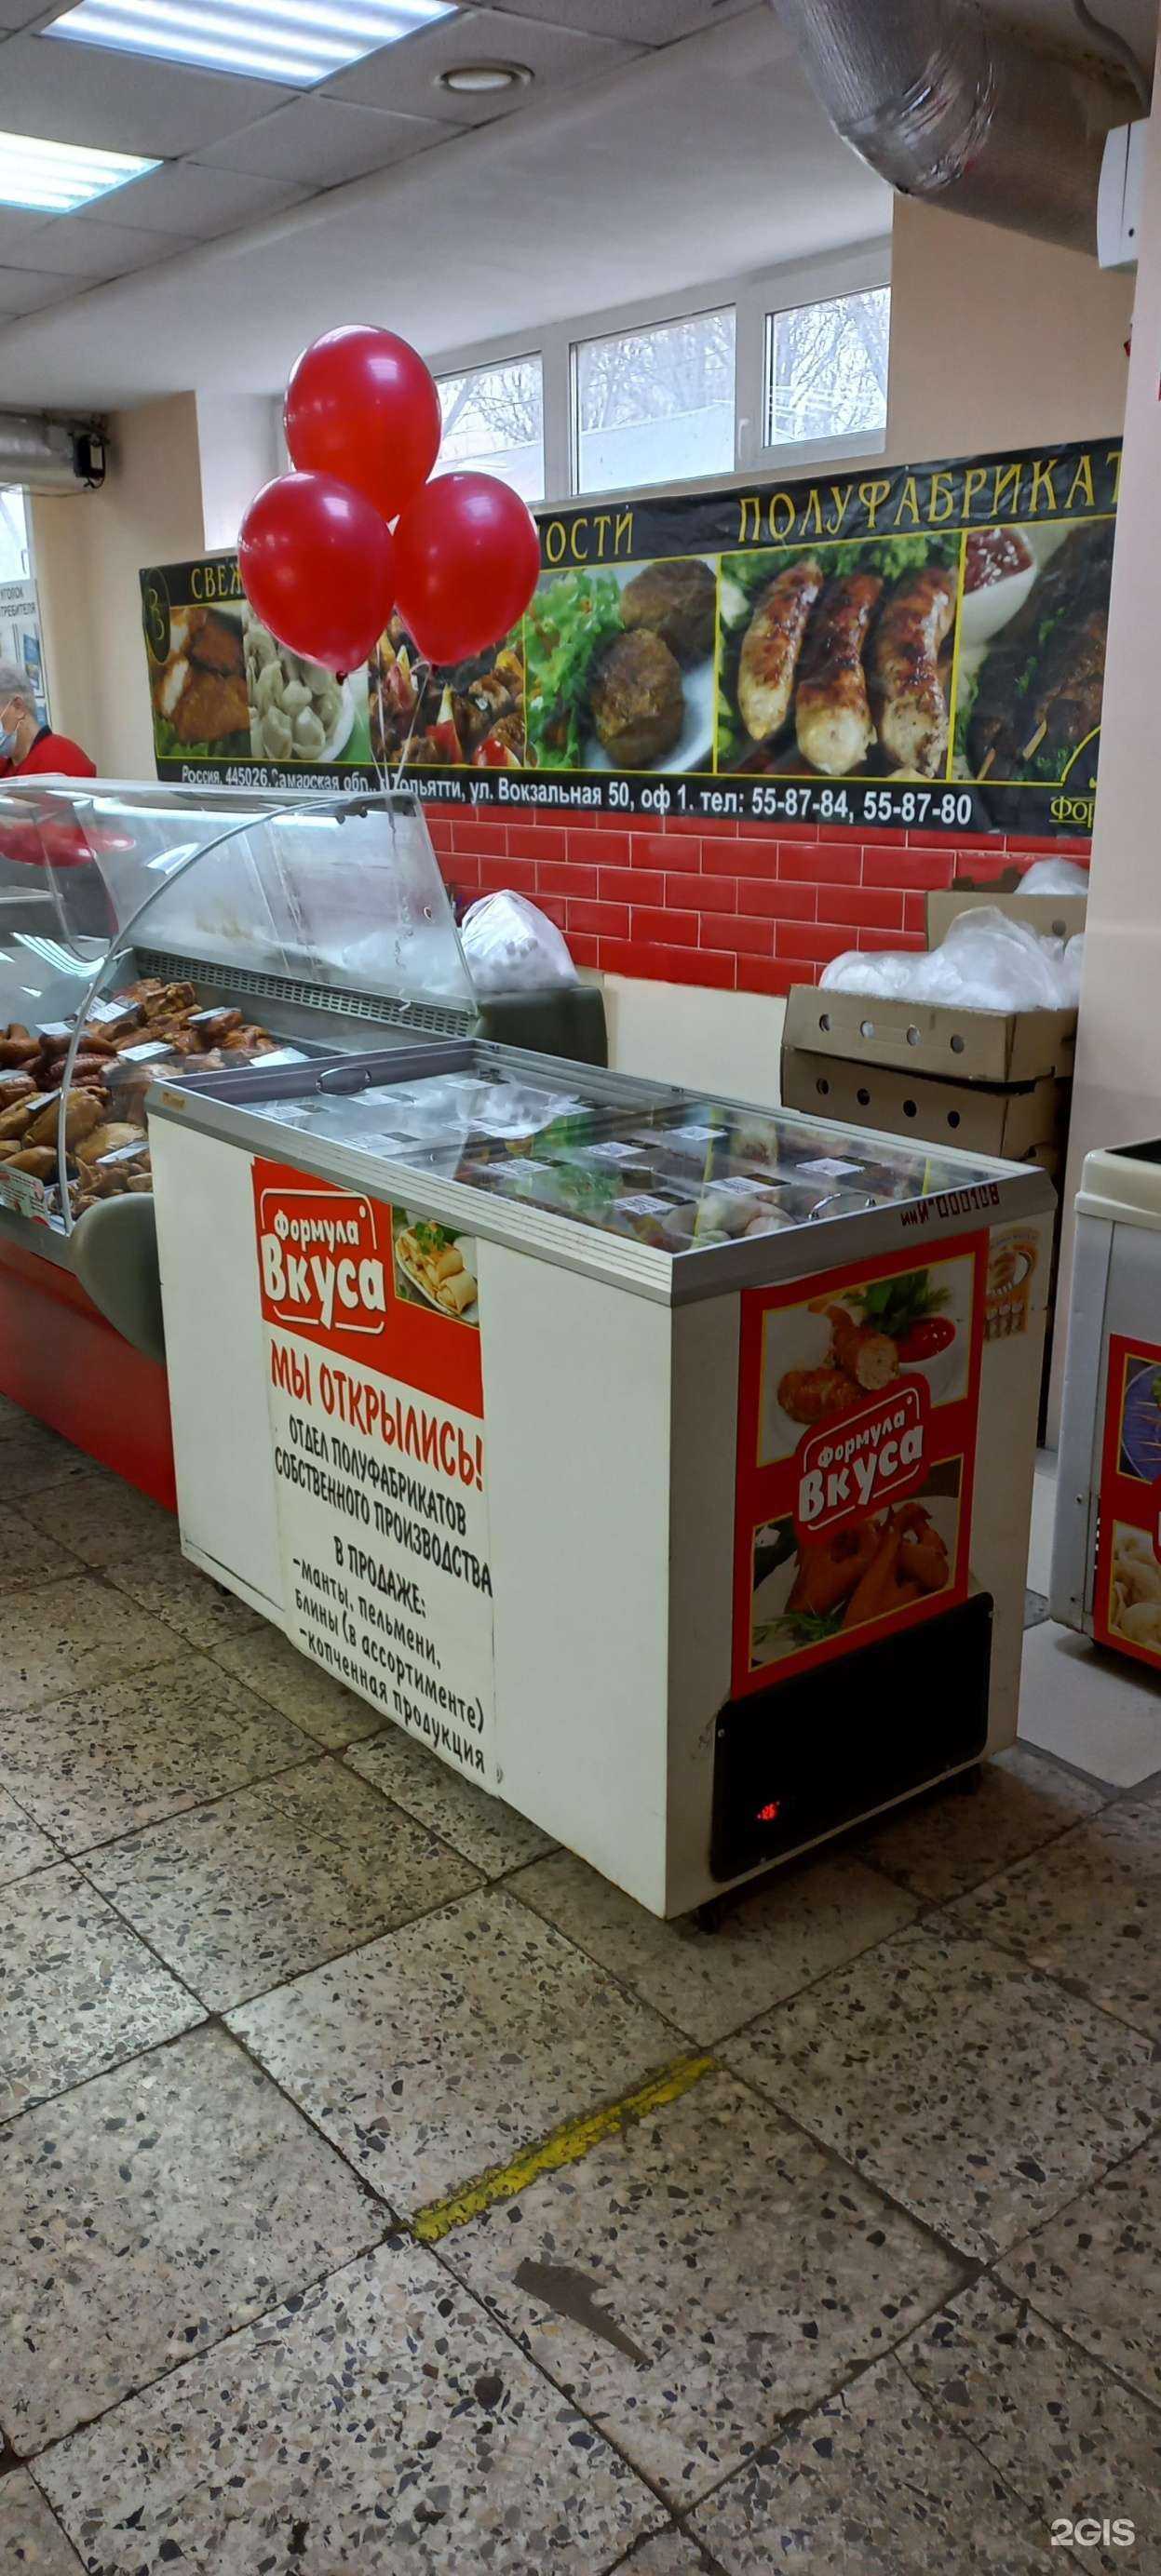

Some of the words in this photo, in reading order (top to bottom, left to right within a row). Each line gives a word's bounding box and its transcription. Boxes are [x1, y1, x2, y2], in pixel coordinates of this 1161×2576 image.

[469, 781, 493, 804] ул.
[499, 777, 601, 806] Вокзальная
[609, 781, 635, 812] 50,
[641, 783, 671, 815] оф
[677, 784, 694, 811] 1.
[700, 791, 744, 813] тел:
[751, 787, 855, 825] 55-87-84,
[863, 791, 972, 825] 55-87-80
[274, 1210, 359, 1254] Формула
[261, 1233, 386, 1330] Вкуса
[270, 1338, 312, 1406] МЫ
[319, 1362, 483, 1493] ОТКРЫЛИСЬ!
[817, 1409, 905, 1469] Формула
[275, 1446, 371, 1525] СОБСТВЕННОГО
[374, 1500, 493, 1598] ПРОИЗВОДСТВА
[290, 1414, 329, 1464] ОТДЕЛ
[331, 1436, 466, 1536] ПОЛУФАБРИКАТОВ
[799, 1425, 925, 1523] Вкуса
[333, 1536, 344, 1566] В
[348, 1544, 426, 1618] ПРОДАЖЕ:
[362, 1637, 485, 1735] ассортименте)
[393, 1689, 486, 1775] продукция
